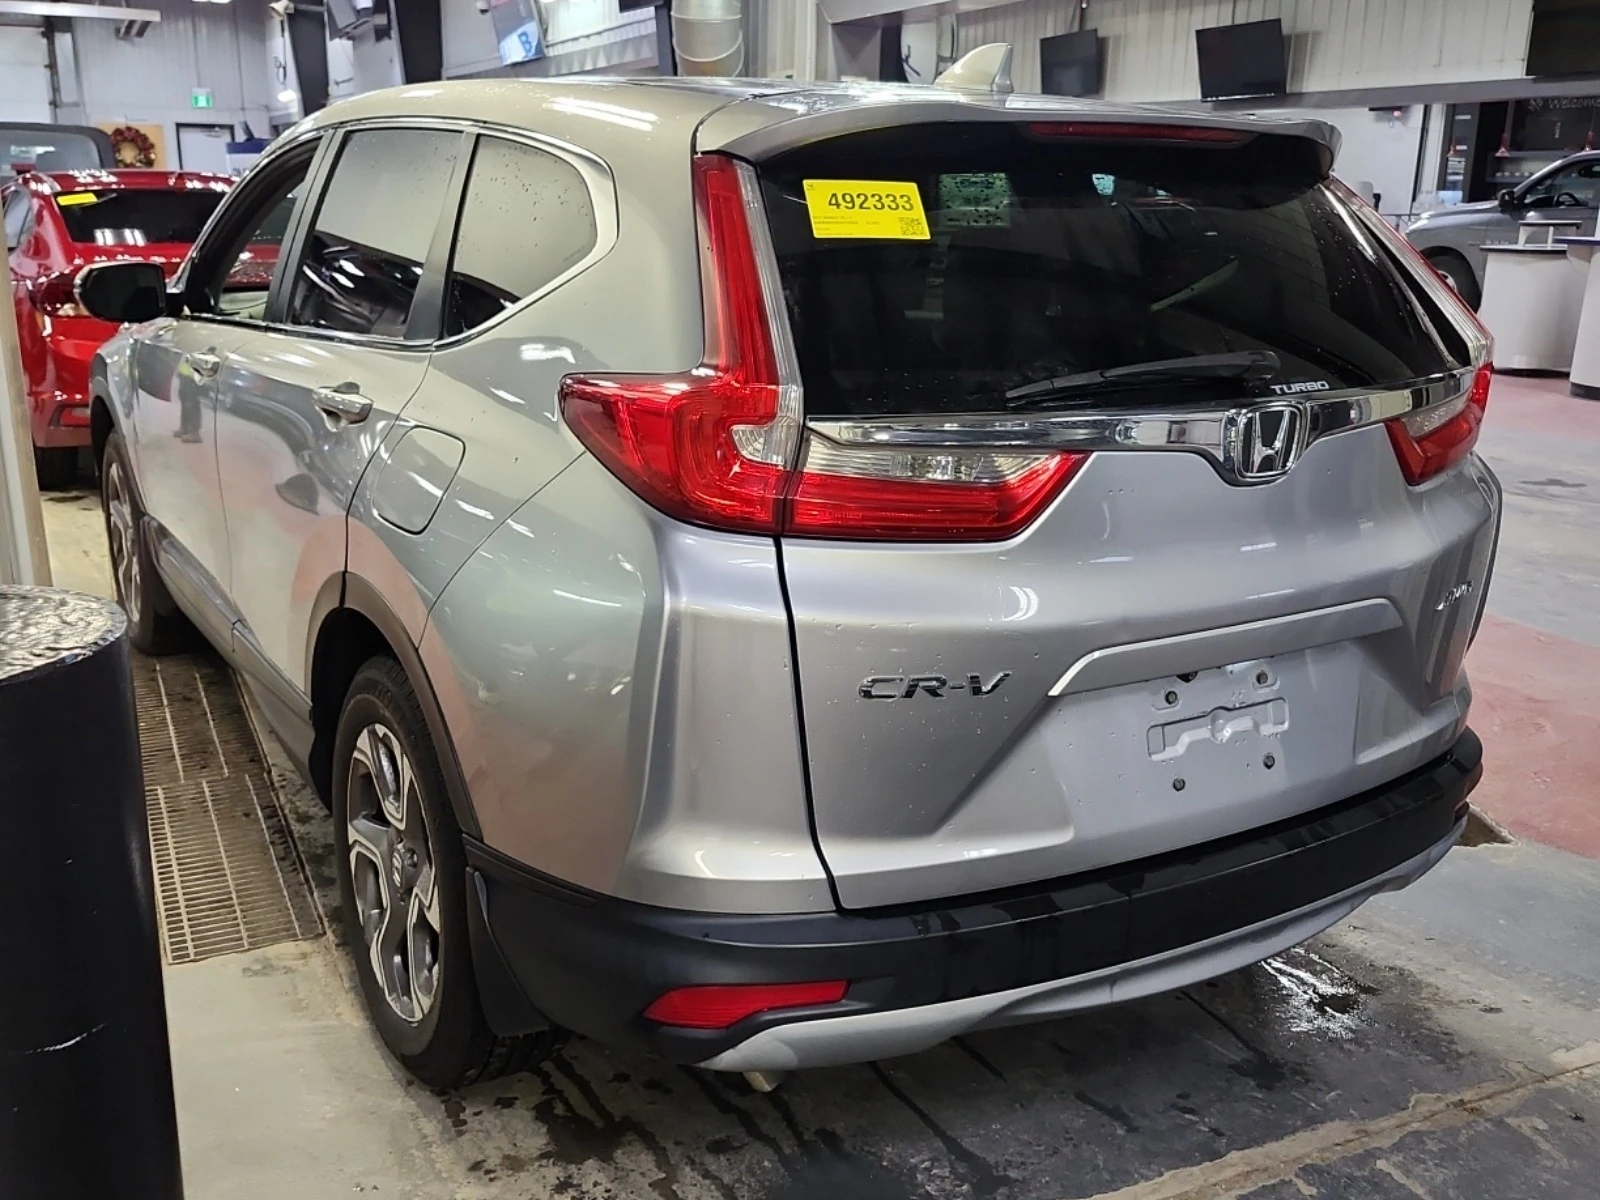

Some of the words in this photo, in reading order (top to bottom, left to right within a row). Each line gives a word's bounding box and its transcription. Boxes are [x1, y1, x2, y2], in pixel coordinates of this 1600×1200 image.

[828, 192, 914, 212] 492333
[1270, 380, 1330, 395] TURBO
[859, 670, 1013, 701] CR-V
